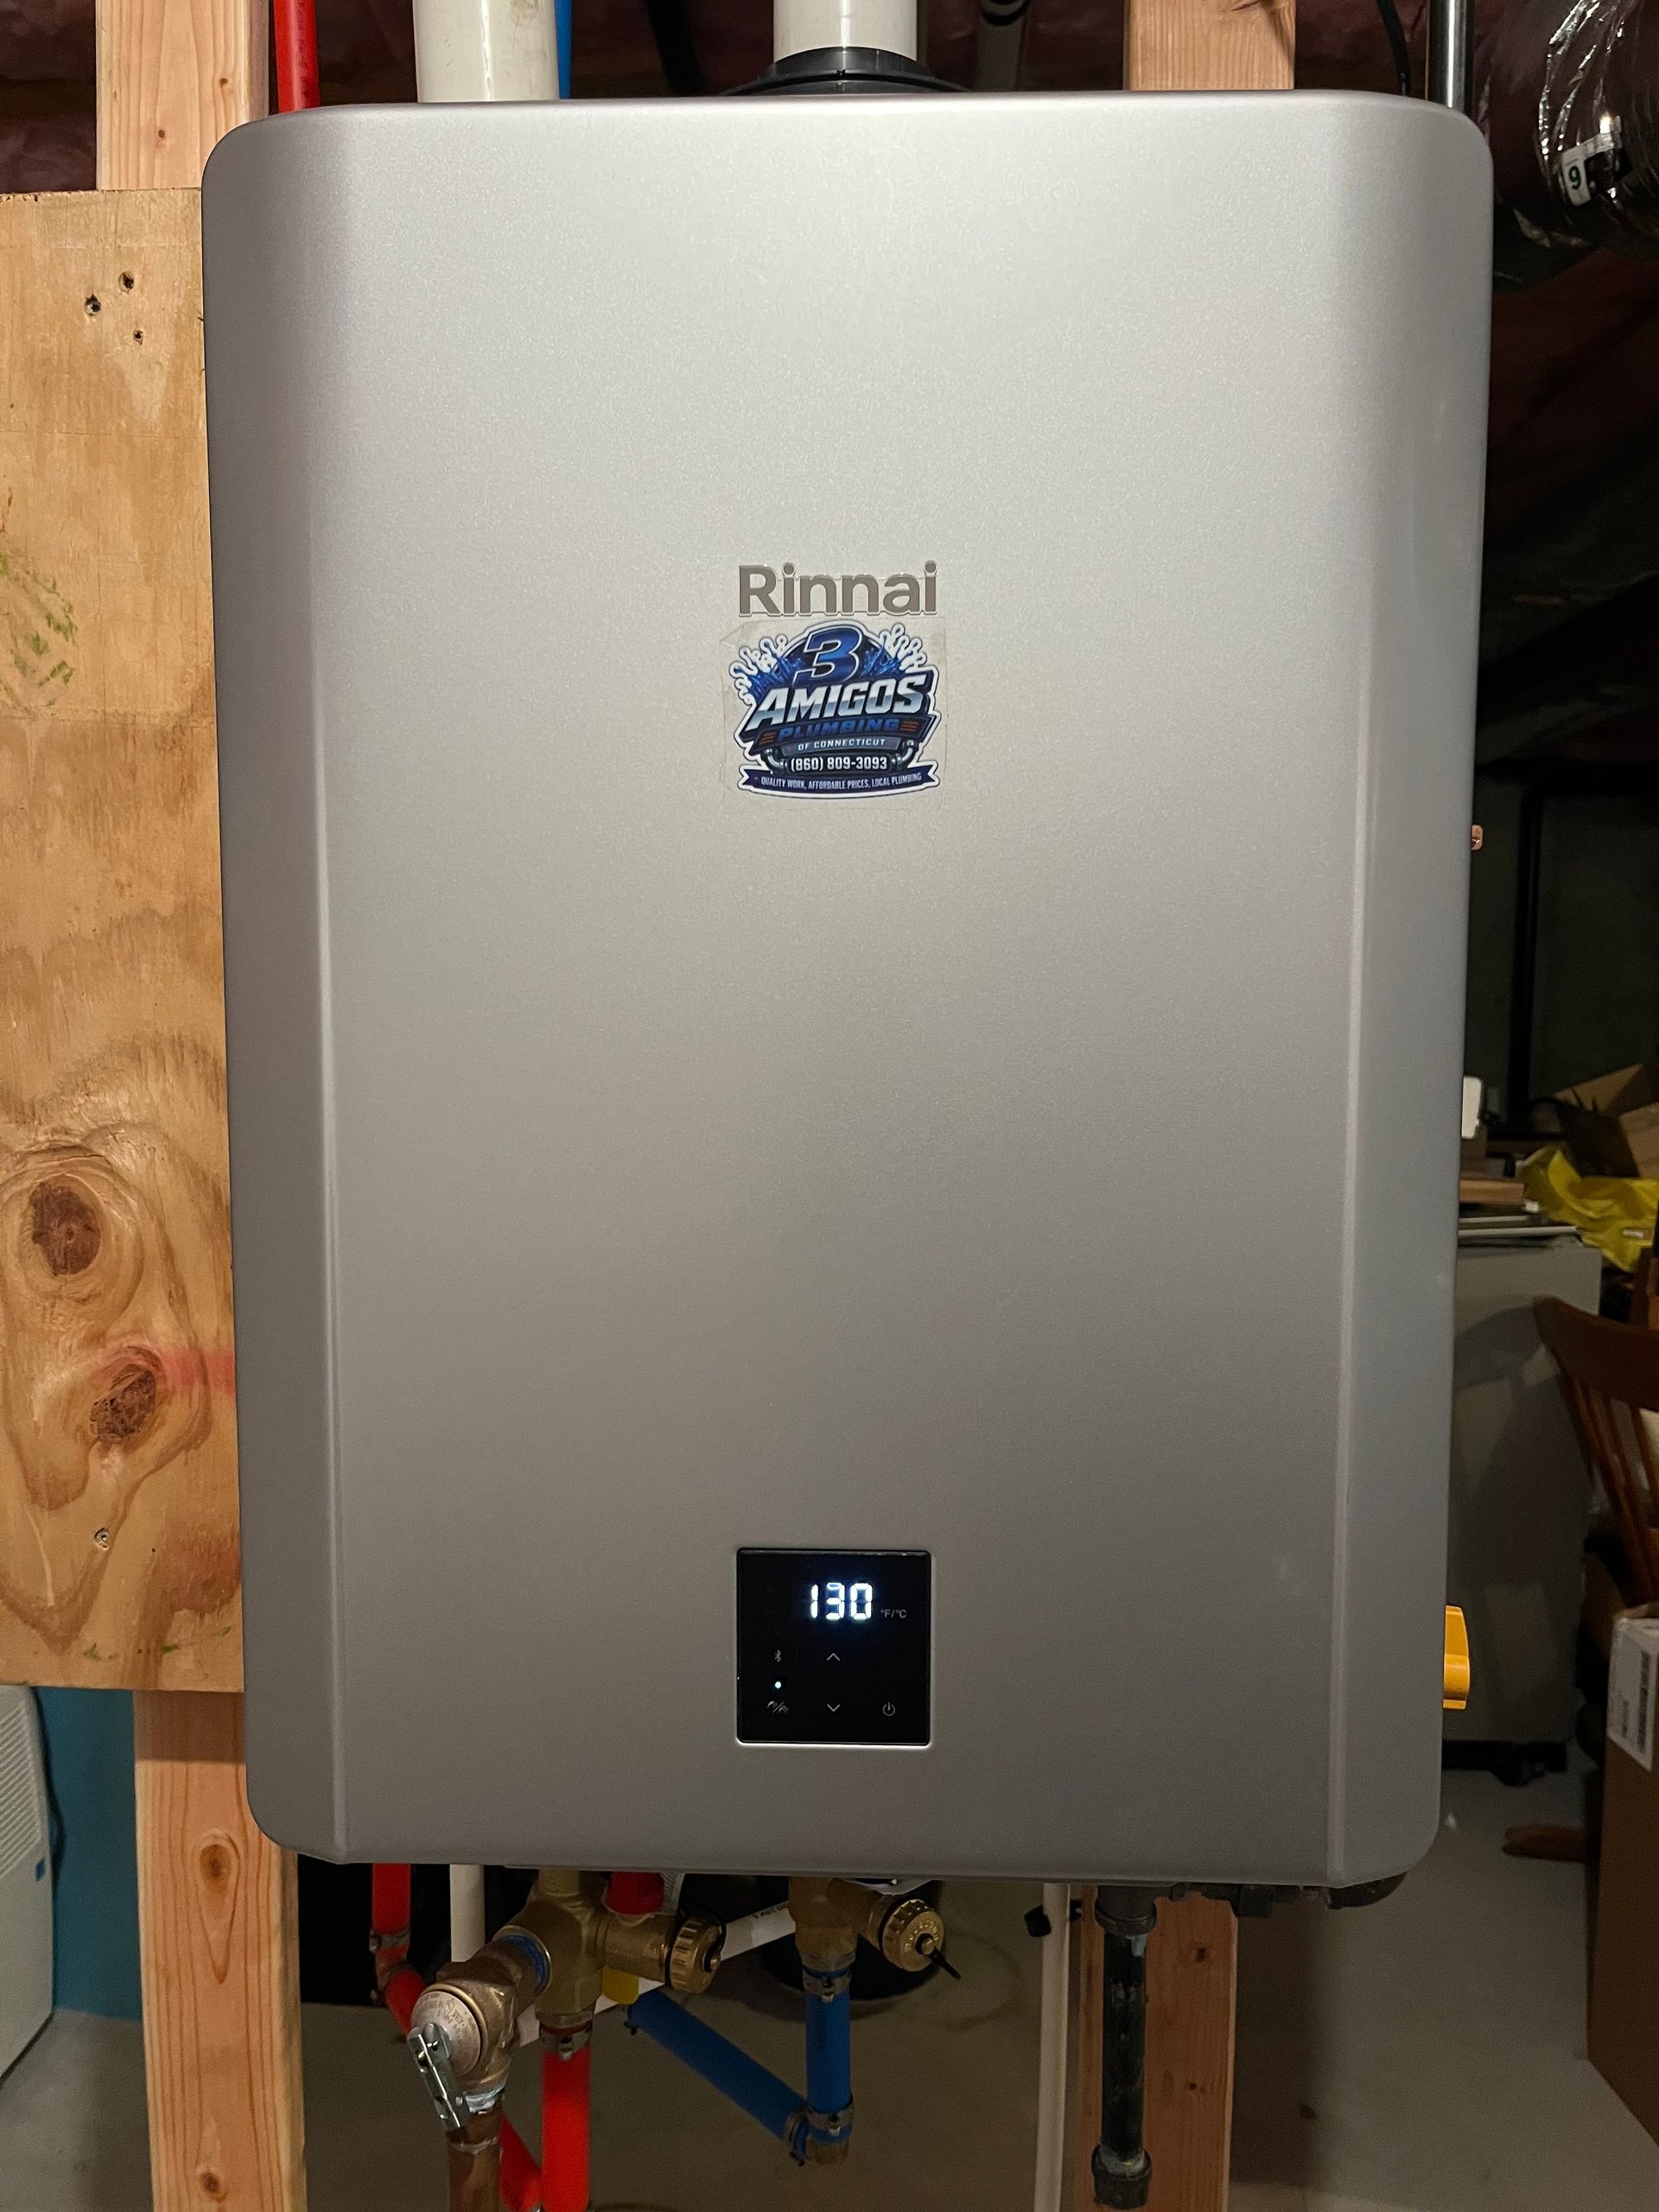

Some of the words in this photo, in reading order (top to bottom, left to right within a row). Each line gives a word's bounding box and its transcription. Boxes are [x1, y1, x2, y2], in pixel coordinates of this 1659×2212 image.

[739, 561, 937, 615] Rinnai
[792, 624, 863, 684] 3
[745, 674, 926, 732] AMIGOS
[778, 718, 899, 741] PLUMBING
[814, 738, 886, 749] CONNECTICUT
[791, 756, 823, 772] (860)
[827, 756, 887, 770] 809-3093
[760, 776, 786, 787] QUALITY
[786, 779, 807, 790] WORK,
[808, 779, 846, 790] AFFORDABLE
[847, 779, 871, 789] PRICES,
[872, 778, 890, 787] LOCAL
[891, 772, 922, 785] PLUMBING
[810, 1582, 873, 1620] 130
